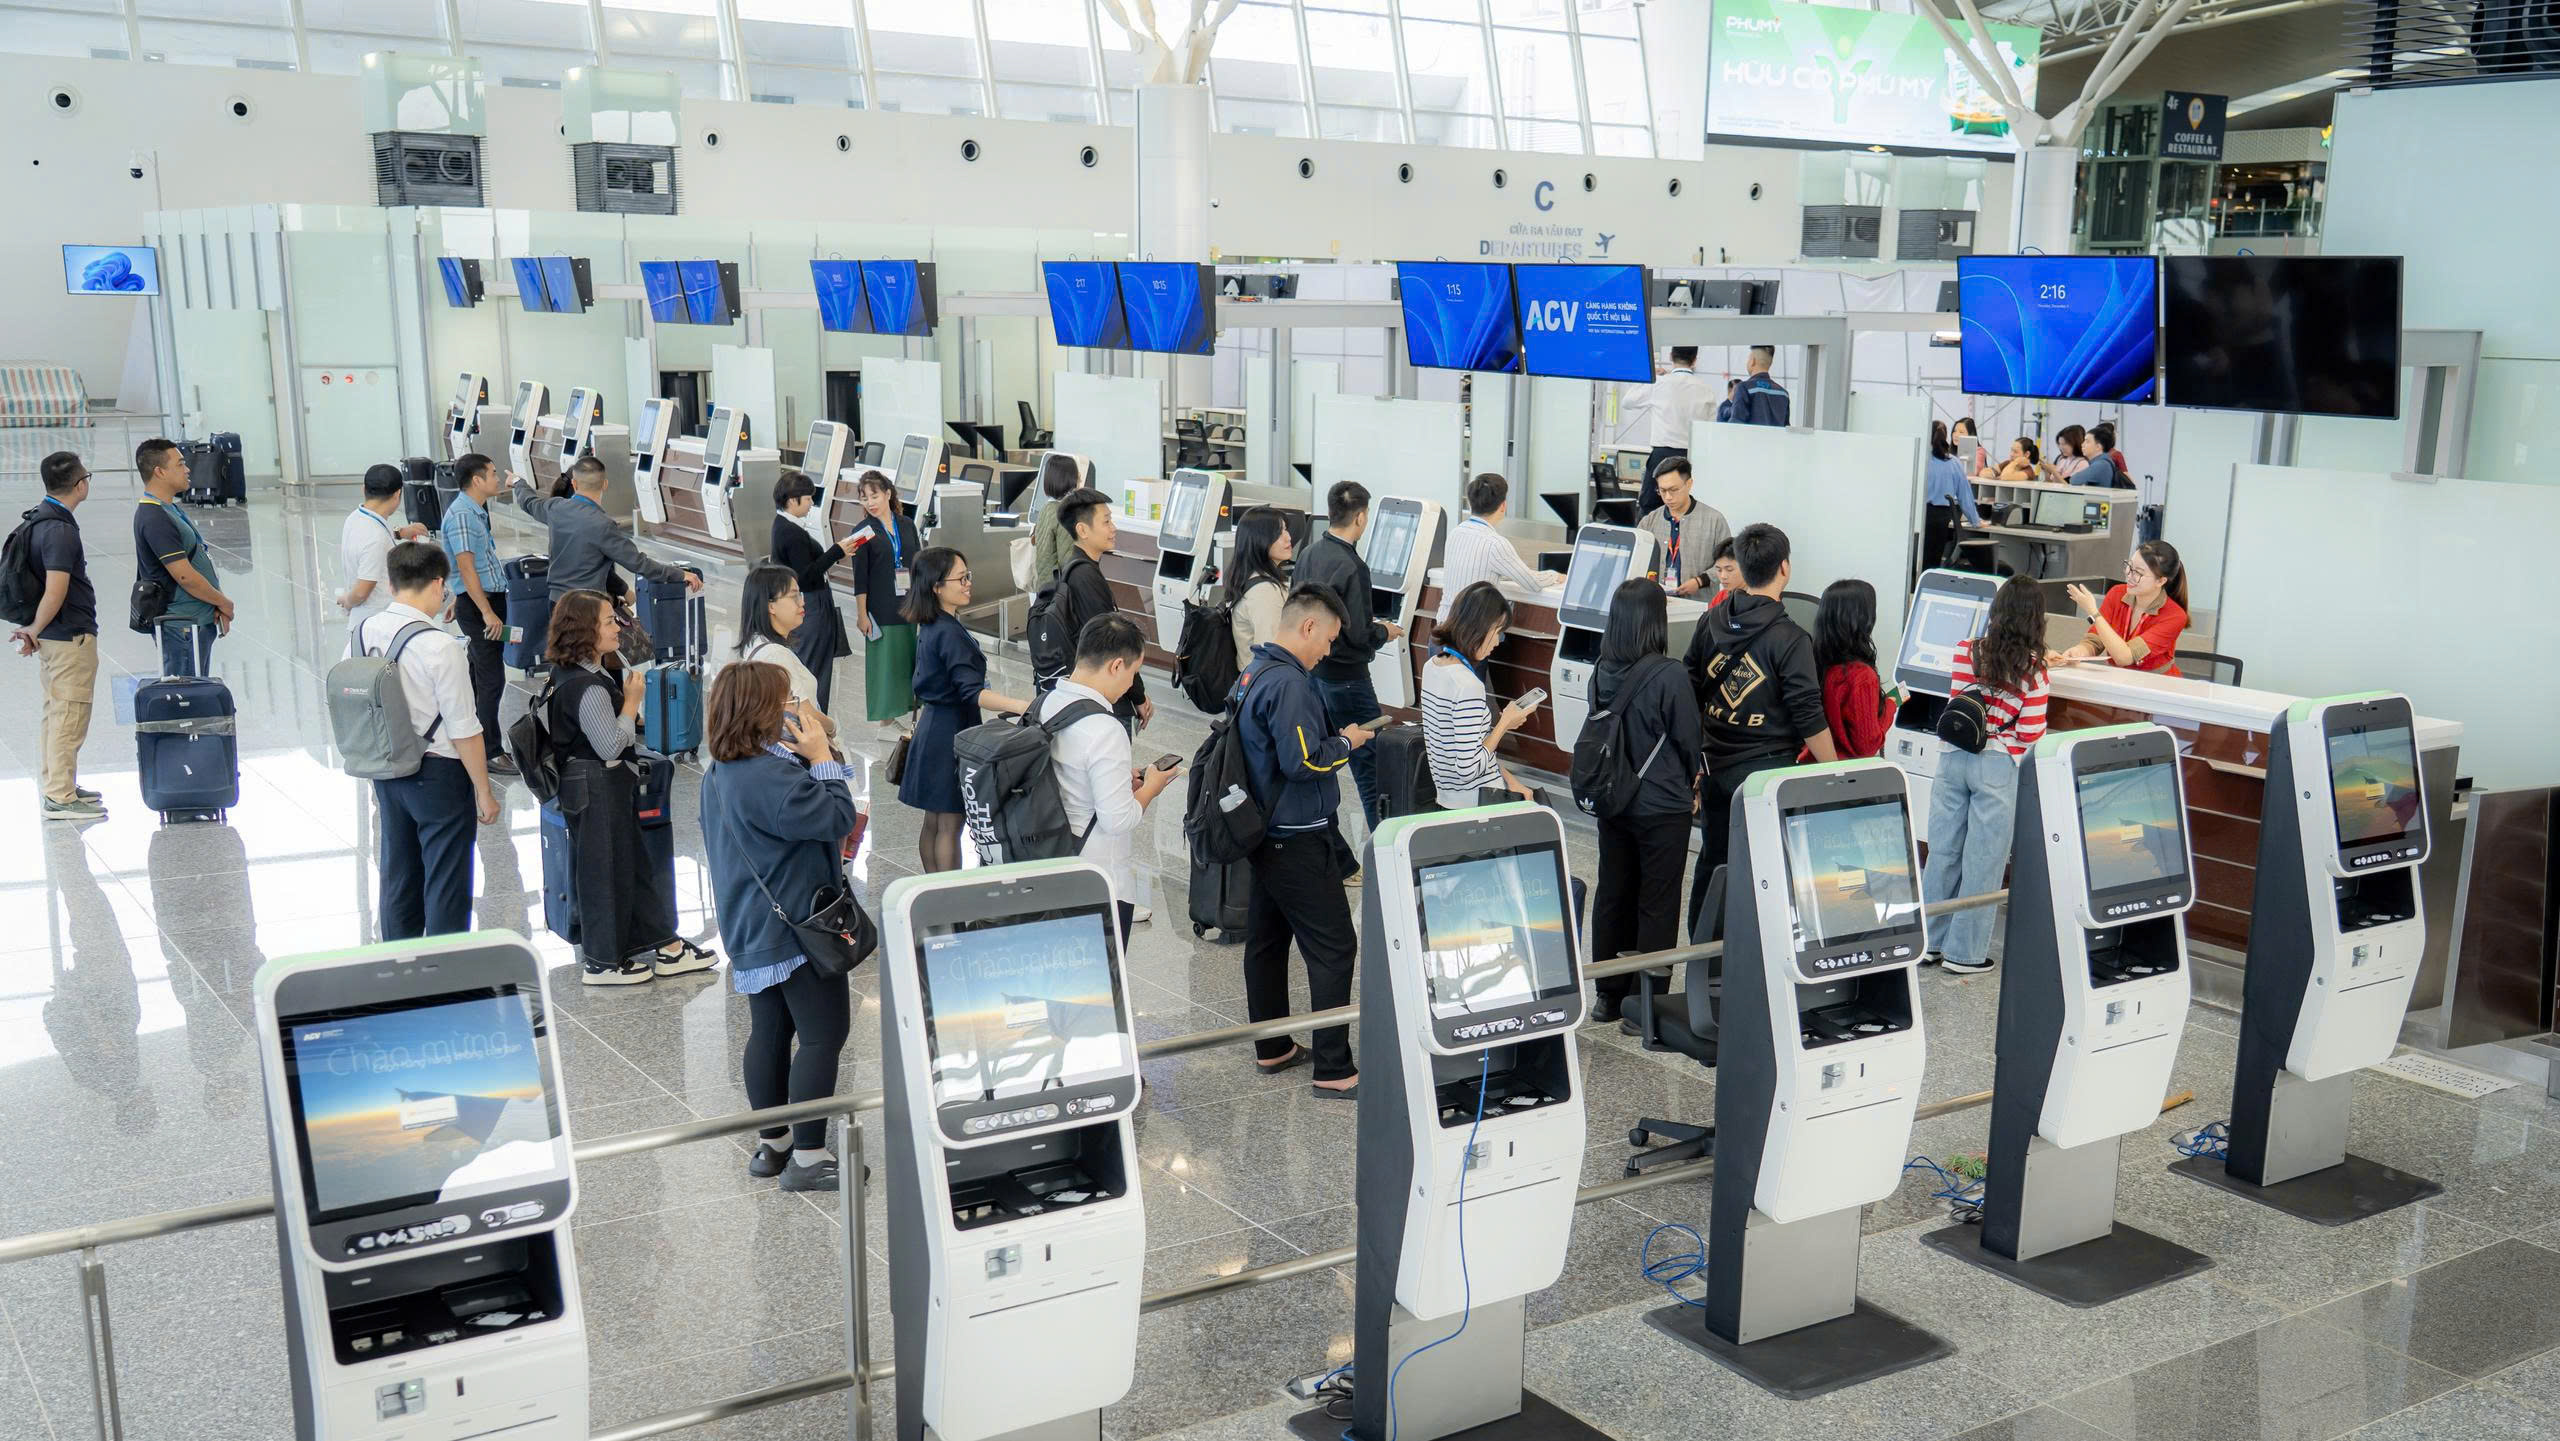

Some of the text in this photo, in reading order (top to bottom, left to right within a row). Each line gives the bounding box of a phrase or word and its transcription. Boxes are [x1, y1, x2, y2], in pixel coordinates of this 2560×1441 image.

[2166, 95, 2180, 110] 4F
[2174, 132, 2213, 145] COFFEE &
[2167, 143, 2218, 156] RESTAURANT
[1534, 180, 1555, 212] C
[1479, 240, 1583, 258] DEPARTURES
[2040, 284, 2066, 300] 2:16
[1525, 299, 1580, 333] ACV
[978, 803, 1000, 843] THE
[327, 1041, 410, 1076] Chào
[419, 1030, 508, 1059] mừng
